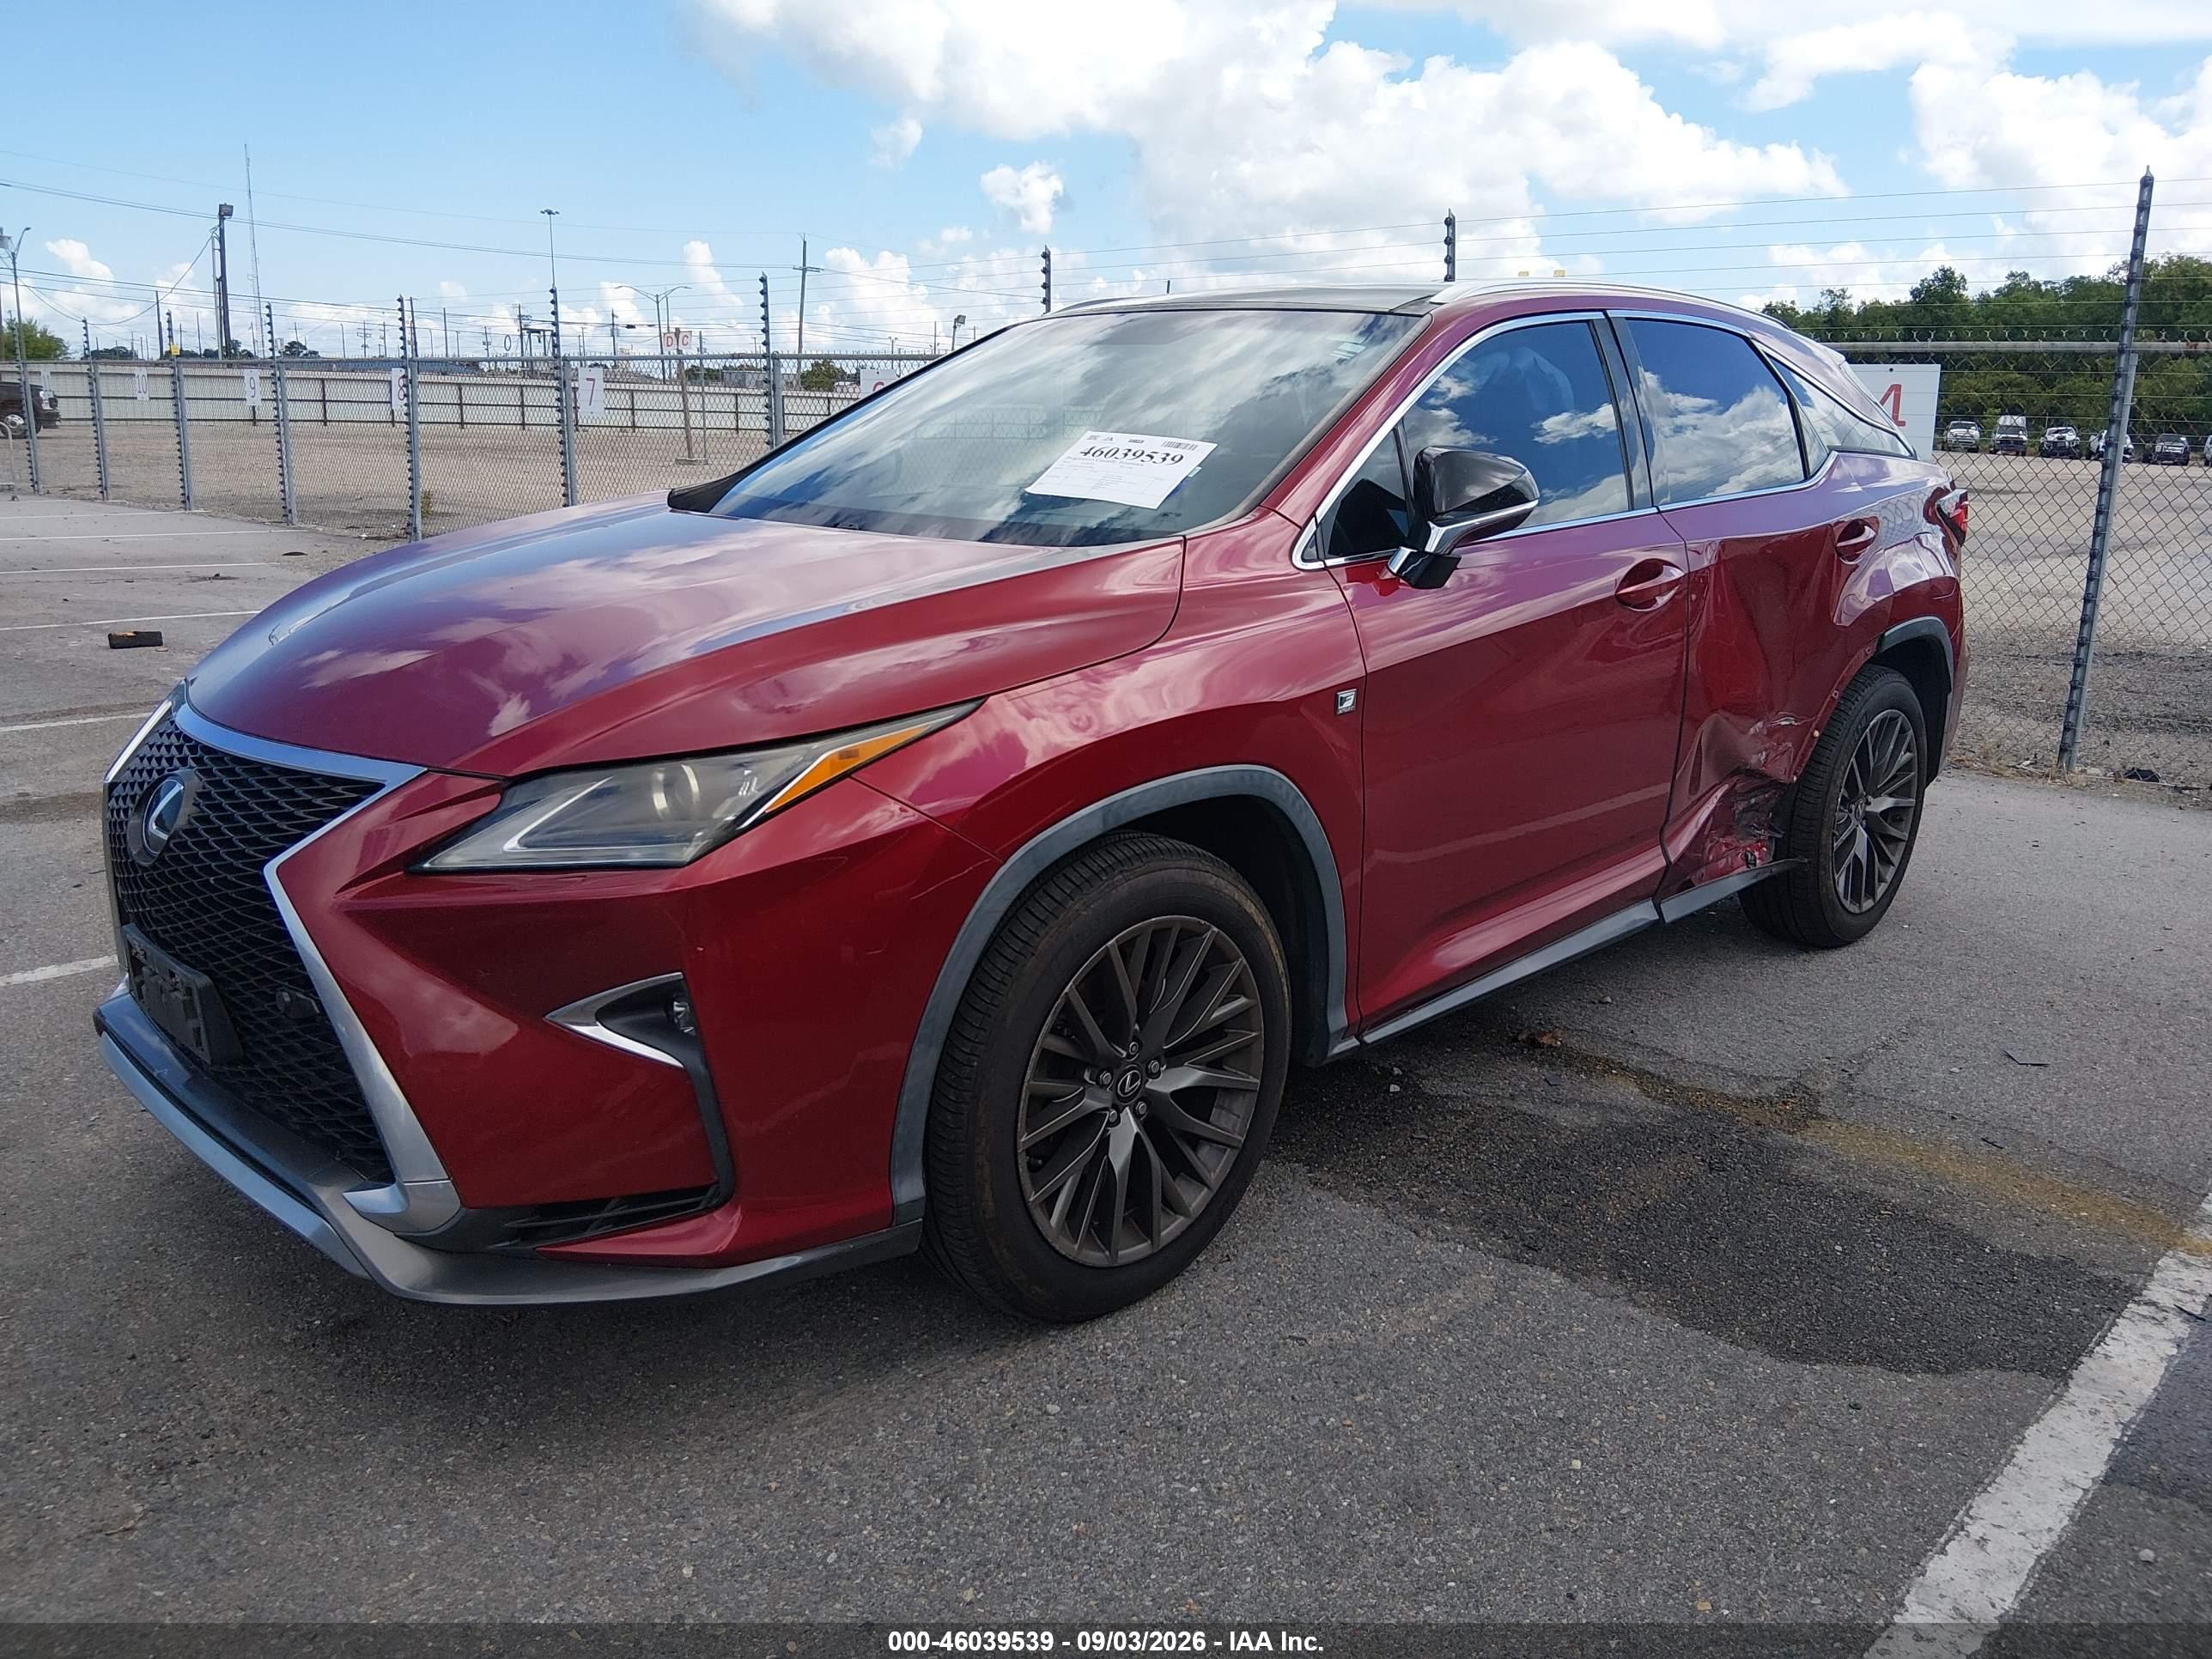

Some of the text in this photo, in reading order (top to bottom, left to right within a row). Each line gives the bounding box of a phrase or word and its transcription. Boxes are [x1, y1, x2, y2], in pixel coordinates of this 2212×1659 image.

[666, 336, 673, 347] D
[682, 335, 689, 346] C
[136, 374, 148, 394] 10
[249, 376, 256, 398] 9
[398, 376, 408, 401] 8
[586, 378, 596, 406] 7
[1879, 383, 1906, 427] 1
[1079, 446, 1184, 465] 46039539
